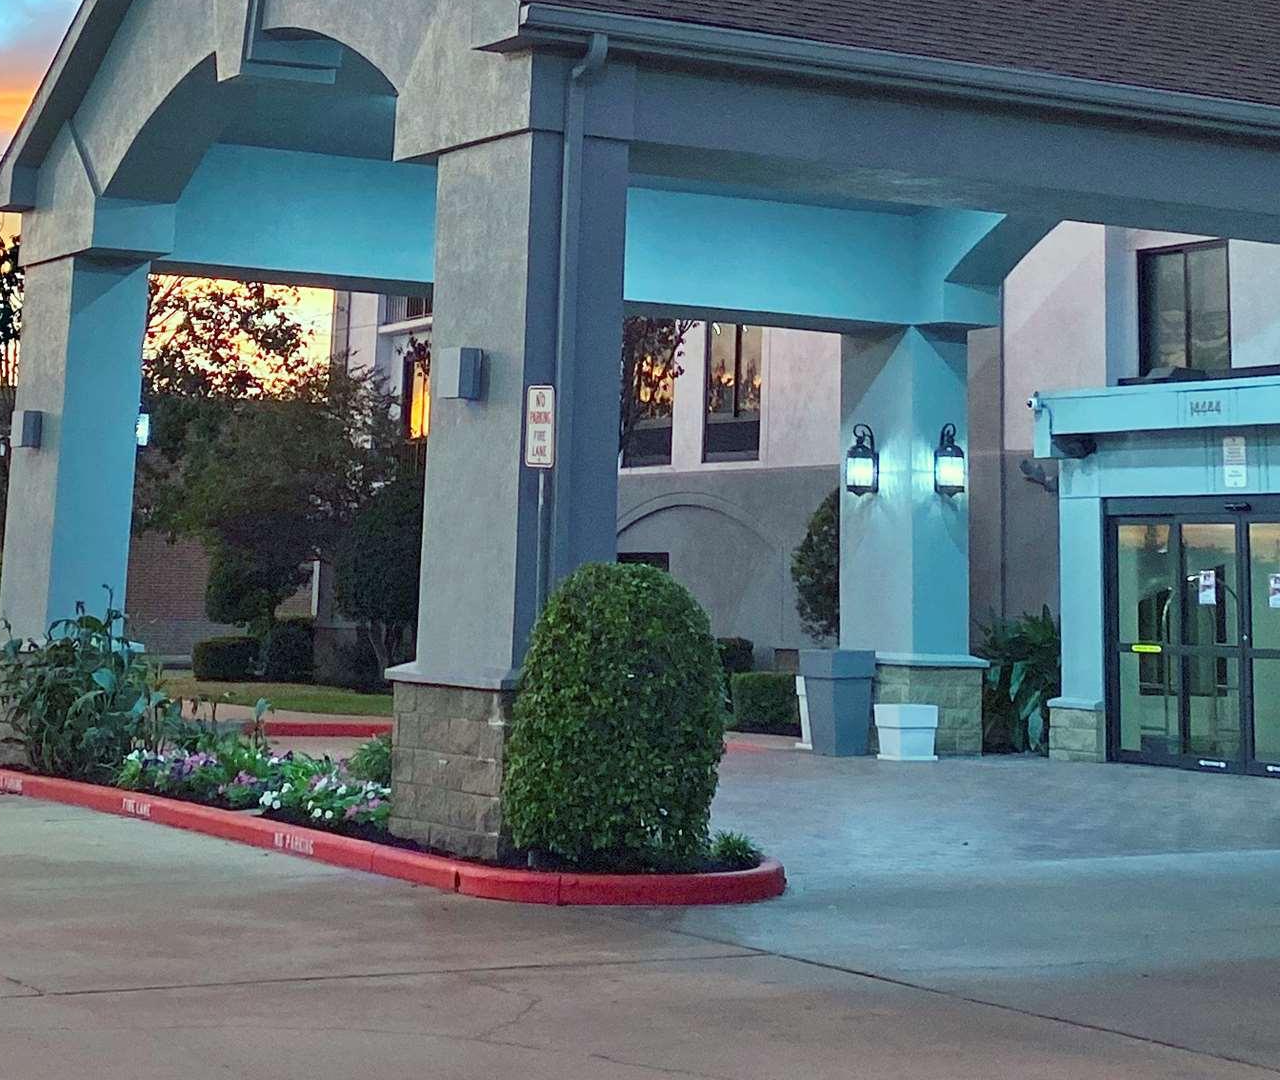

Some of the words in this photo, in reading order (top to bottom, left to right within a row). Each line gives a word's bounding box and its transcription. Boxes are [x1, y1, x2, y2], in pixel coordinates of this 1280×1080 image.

[535, 391, 546, 407] NO
[530, 411, 552, 424] PARKING
[533, 430, 546, 441] FIRE
[532, 445, 547, 456] LANE
